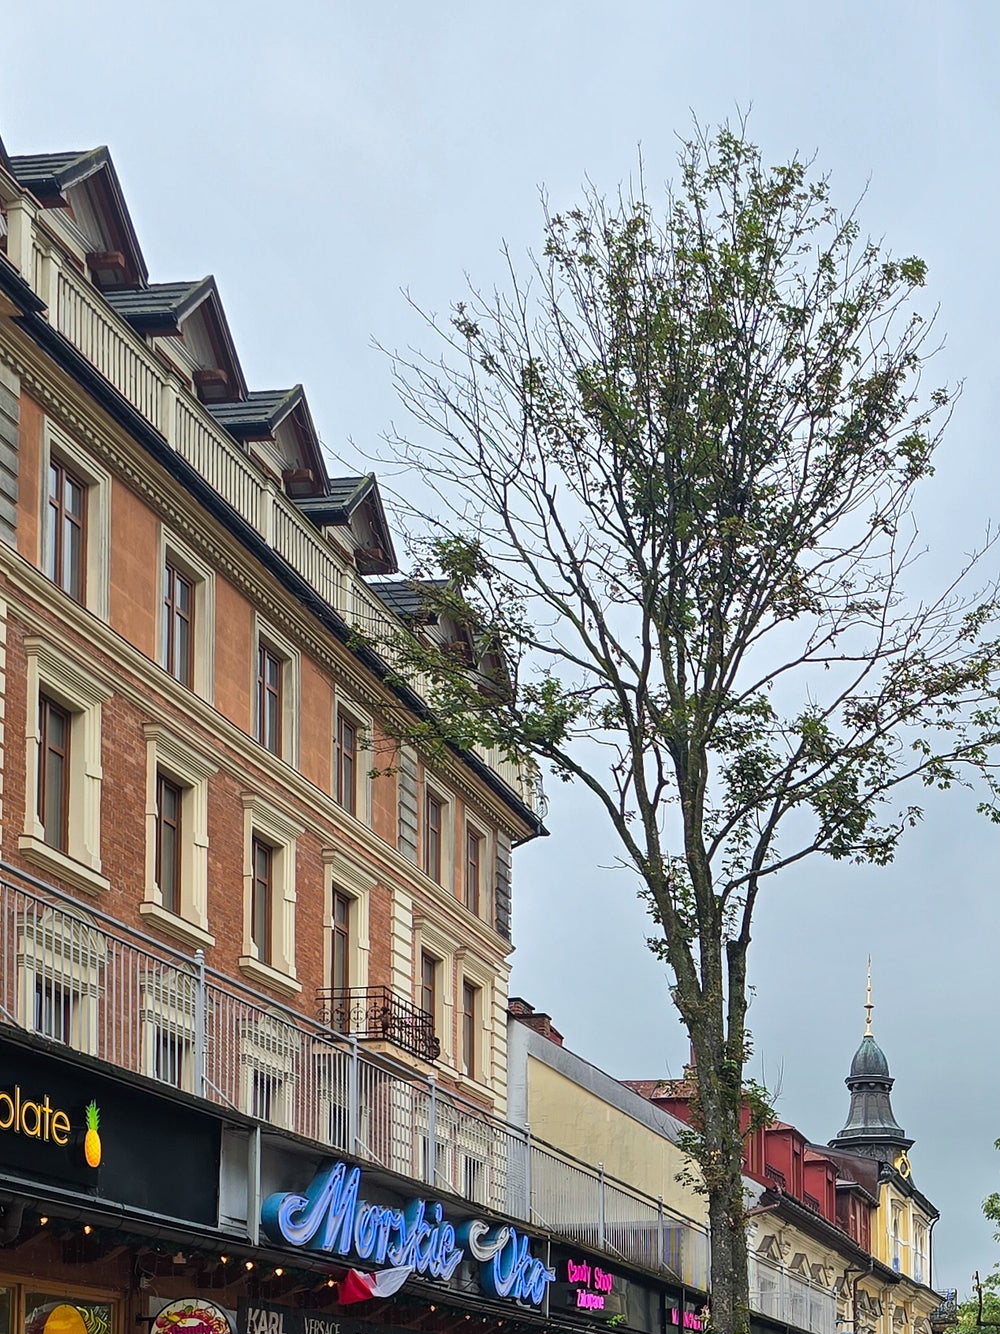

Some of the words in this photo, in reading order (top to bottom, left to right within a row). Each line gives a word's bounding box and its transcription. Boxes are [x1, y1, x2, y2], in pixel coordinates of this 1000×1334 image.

[266, 1160, 463, 1281] Morskie
[468, 1218, 556, 1305] Oko
[568, 1259, 592, 1288] Candy
[594, 1266, 613, 1295] Shop
